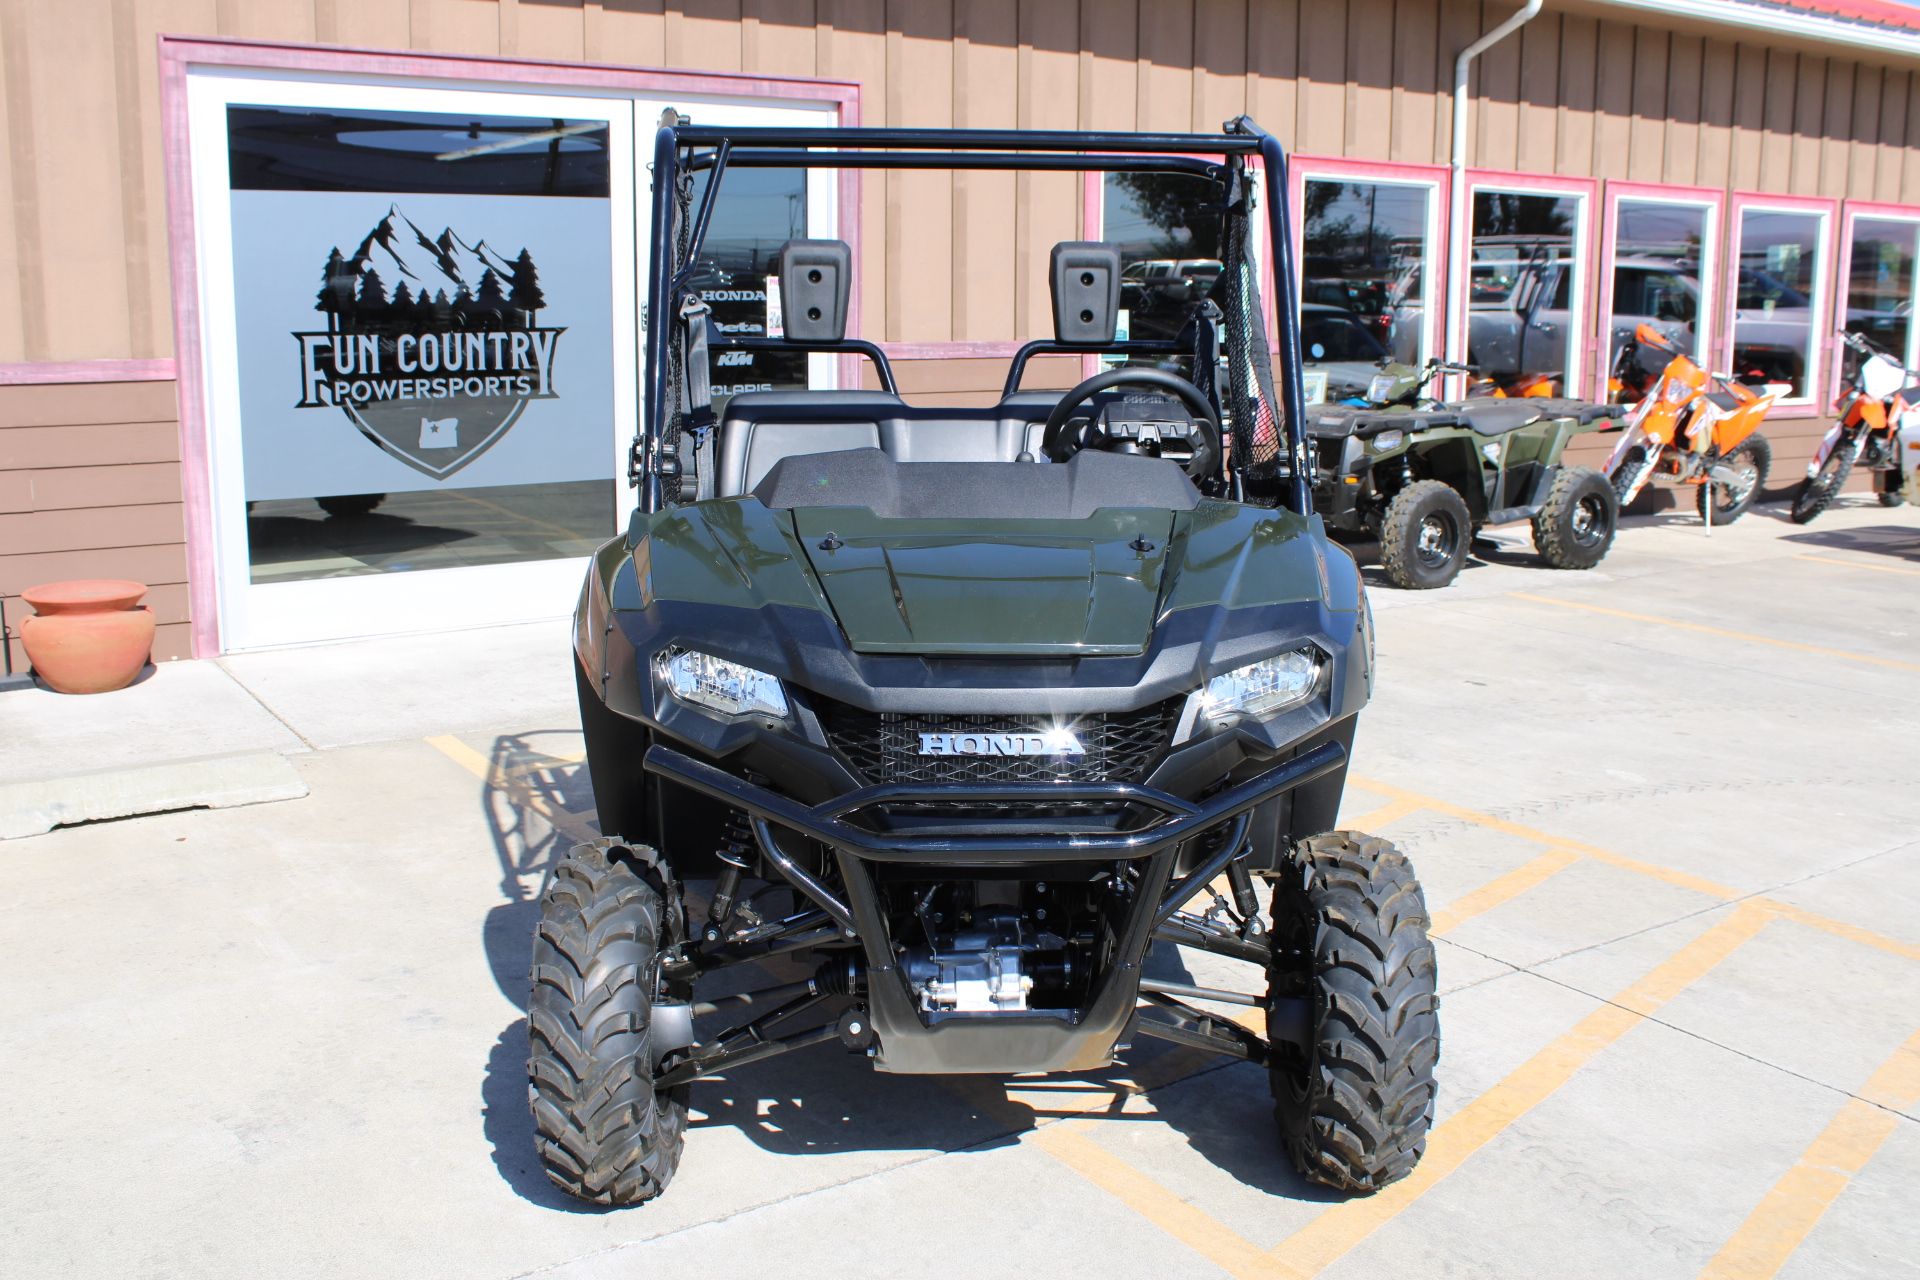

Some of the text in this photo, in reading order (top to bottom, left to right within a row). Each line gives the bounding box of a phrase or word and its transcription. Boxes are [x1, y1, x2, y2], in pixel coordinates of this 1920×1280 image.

[701, 290, 767, 300] HONDA
[301, 331, 558, 403] FUN COUNTRY
[717, 351, 753, 366] KTM
[335, 375, 531, 402] POWERSPORTS
[711, 384, 772, 396] OLARIS
[917, 732, 1087, 756] HONDA
